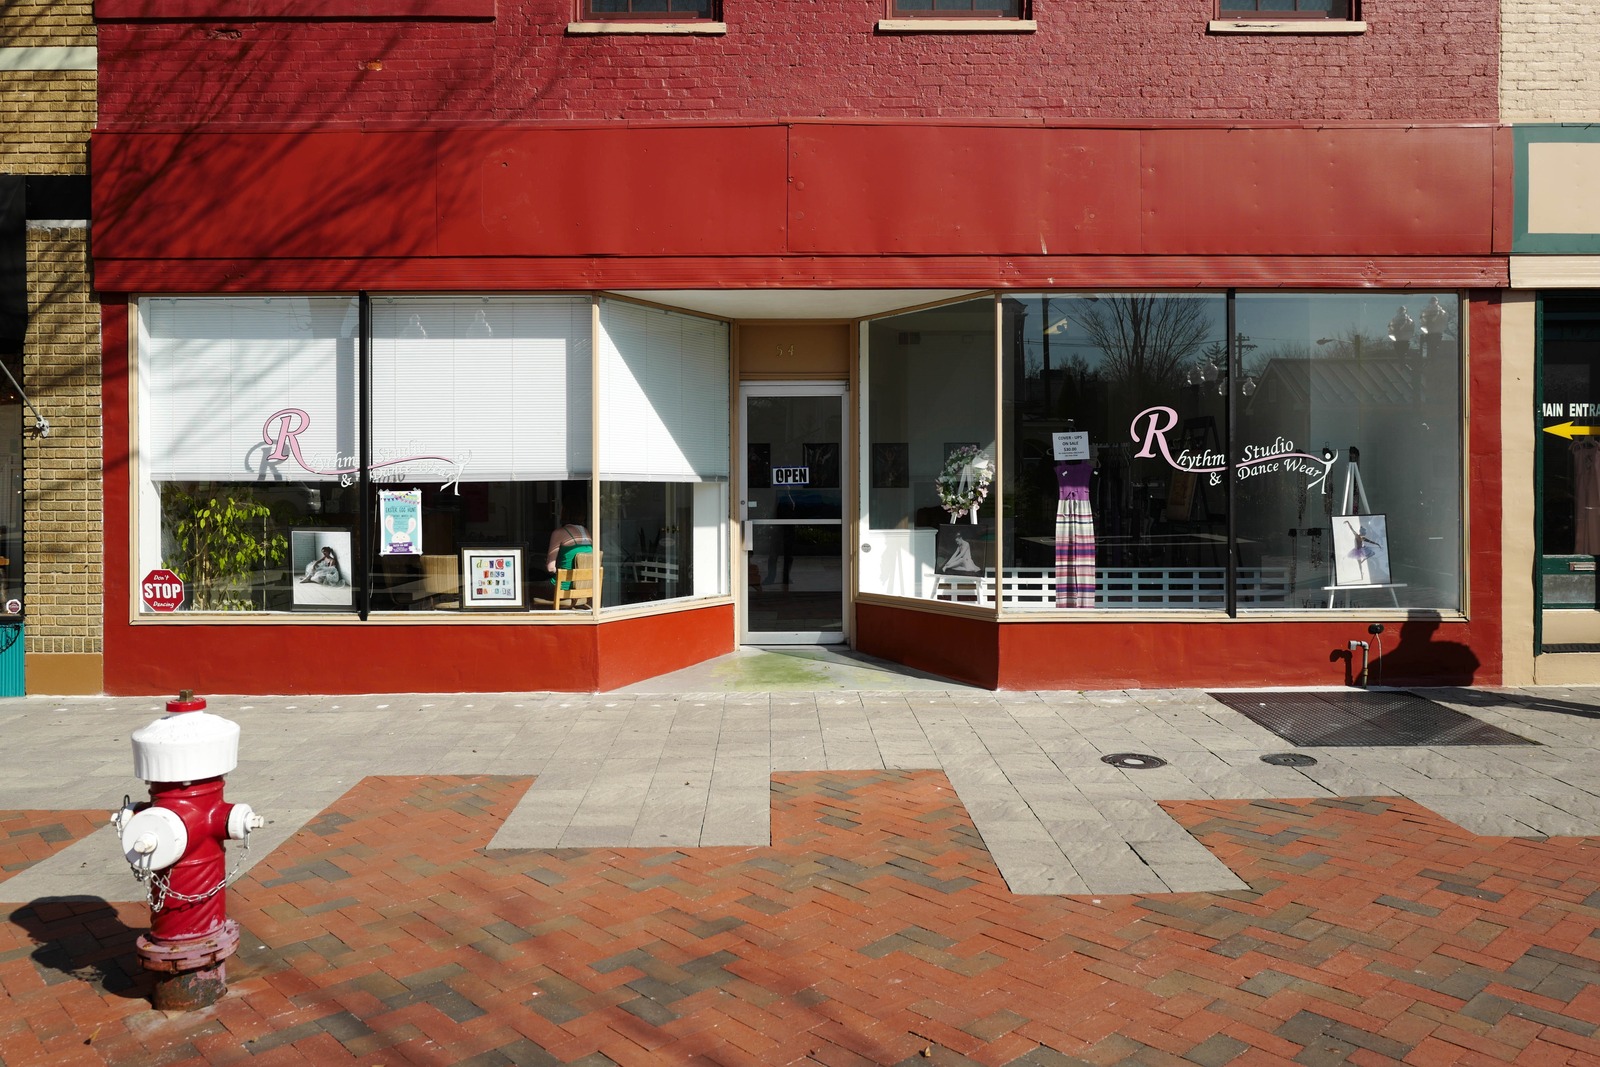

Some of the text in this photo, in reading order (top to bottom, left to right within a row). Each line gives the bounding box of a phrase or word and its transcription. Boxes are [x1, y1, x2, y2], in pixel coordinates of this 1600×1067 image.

[1130, 405, 1294, 472] Rhythm Studio
[775, 468, 808, 484] OPEN
[1209, 457, 1322, 486] & Dance Wear
[340, 473, 353, 488] &
[144, 583, 181, 599] STOP
